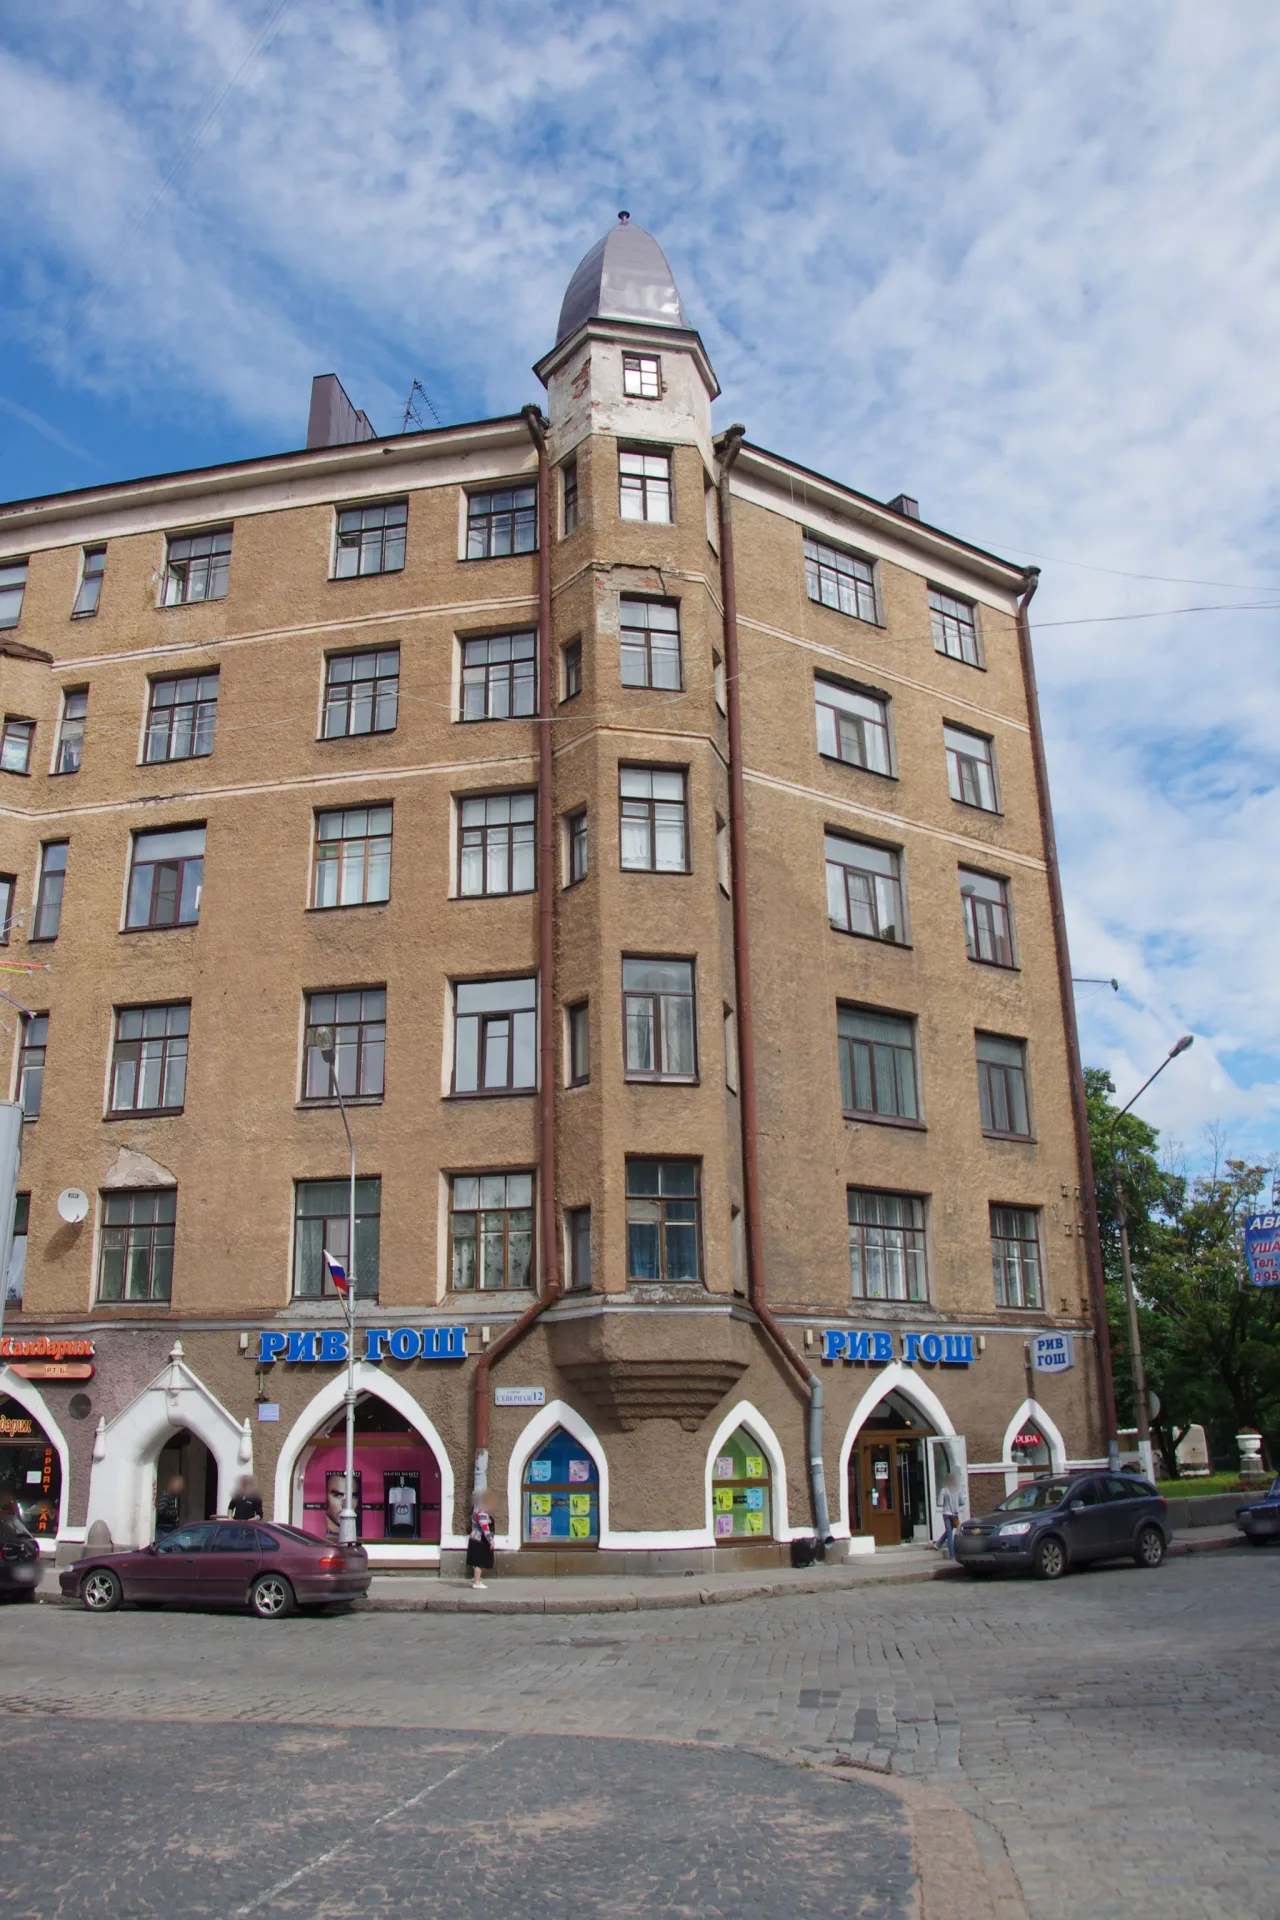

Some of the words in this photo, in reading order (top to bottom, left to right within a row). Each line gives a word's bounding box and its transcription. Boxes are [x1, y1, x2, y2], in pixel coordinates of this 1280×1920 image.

[1250, 1216, 1280, 1230] АВ
[1254, 1272, 1261, 1283] 8
[1264, 1270, 1280, 1282] 95
[258, 1330, 349, 1362] РИВ
[364, 1327, 468, 1360] ГОШ
[822, 1330, 893, 1360] РИВ
[903, 1333, 974, 1362] ГОШ
[1037, 1338, 1064, 1351] РИВ
[1037, 1352, 1066, 1366] ГОШ
[533, 1391, 543, 1401] 12
[1015, 1435, 1038, 1443] PUPA
[42, 1448, 52, 1493] SPORT
